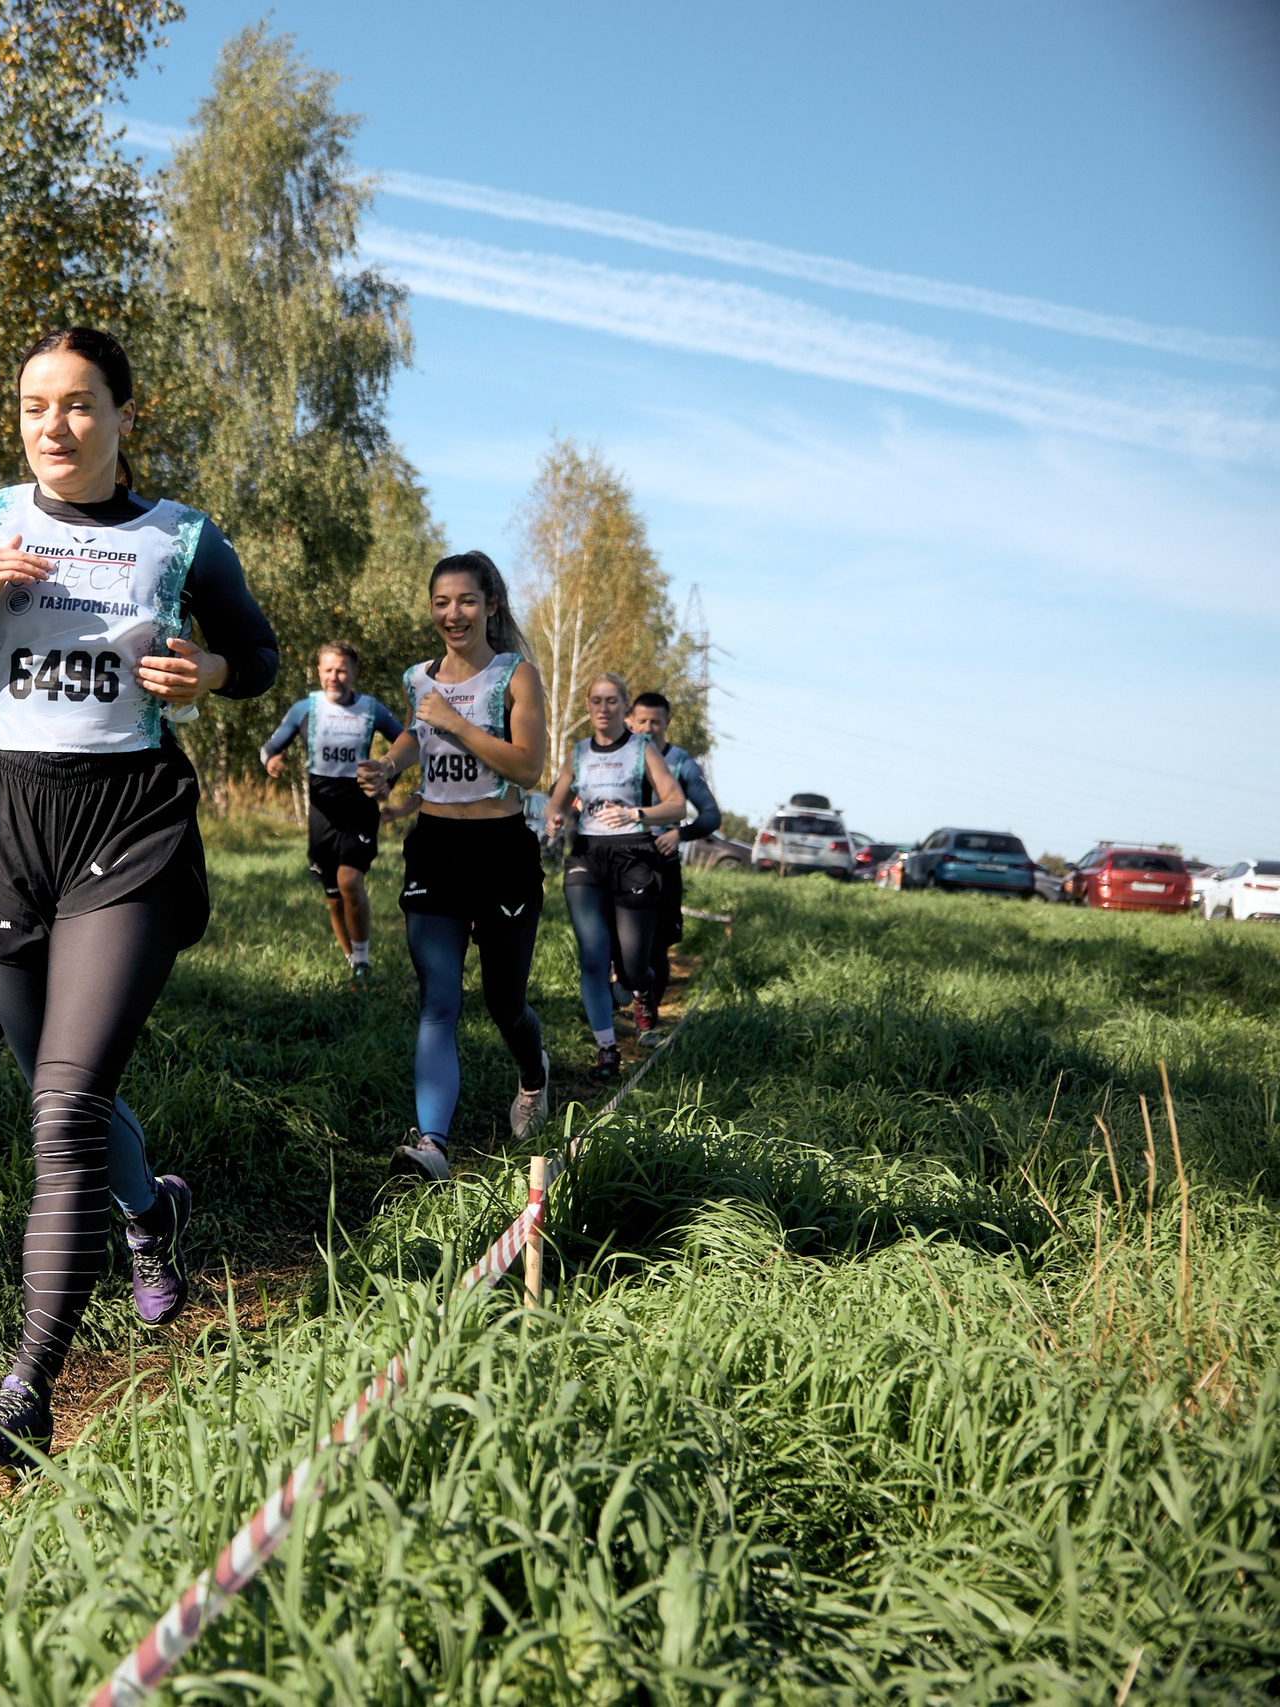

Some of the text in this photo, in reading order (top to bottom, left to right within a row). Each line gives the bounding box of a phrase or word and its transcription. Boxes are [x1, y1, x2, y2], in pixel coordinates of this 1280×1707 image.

[25, 544, 138, 563] ГОНКА ГЕРОЕВ
[39, 595, 139, 618] ГАЗПРОМБАНК
[8, 647, 122, 703] 6496
[322, 746, 357, 763] 6490
[427, 753, 479, 783] 6498
